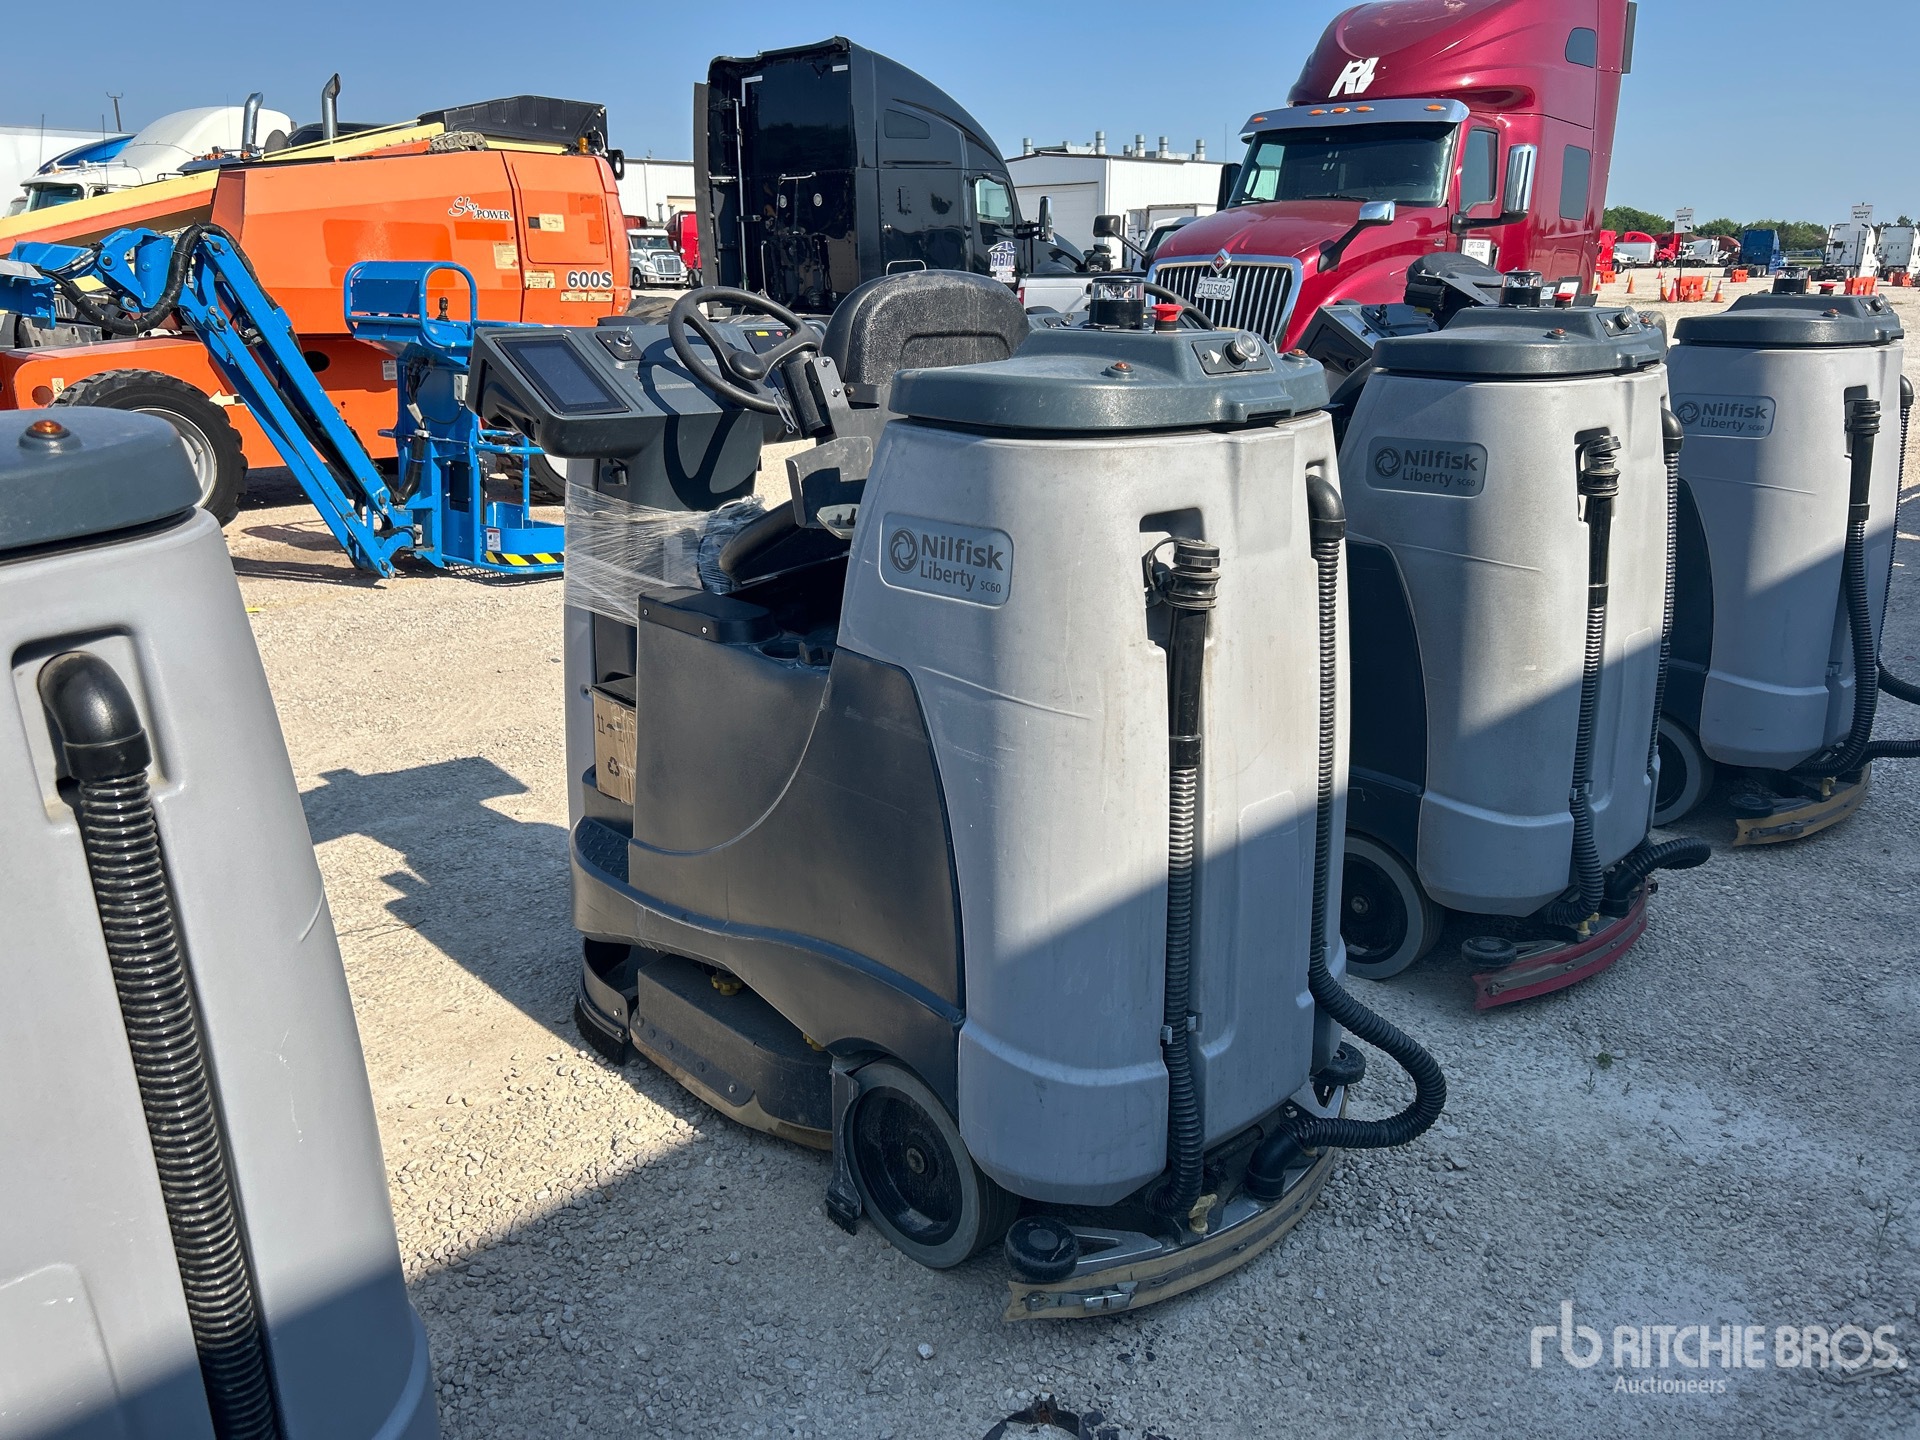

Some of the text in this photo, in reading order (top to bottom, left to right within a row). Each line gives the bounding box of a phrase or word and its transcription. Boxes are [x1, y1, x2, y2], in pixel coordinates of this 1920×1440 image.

[474, 210, 512, 220] POWER
[567, 271, 613, 288] 600S
[1702, 403, 1767, 419] Nilfisk
[1700, 417, 1745, 432] Liberty
[1403, 450, 1478, 471] Nilfisk
[1402, 468, 1475, 487] Liberty SC60
[921, 534, 1003, 571] Nilfisk
[920, 560, 1001, 593] Liberty SC60
